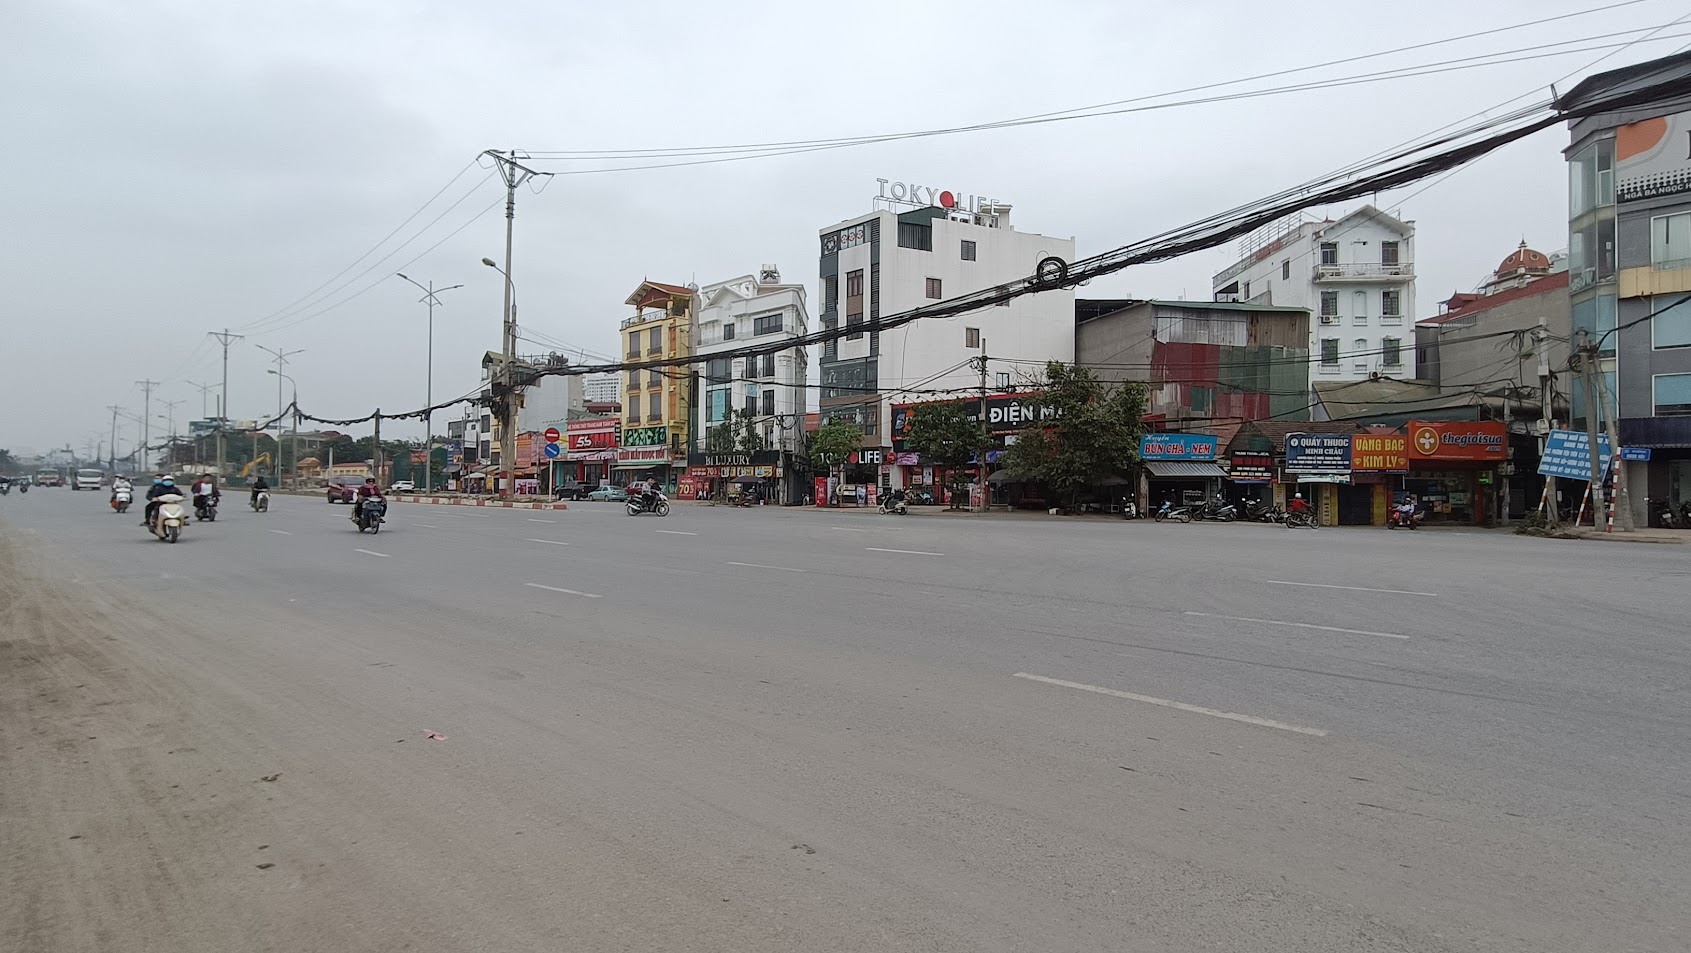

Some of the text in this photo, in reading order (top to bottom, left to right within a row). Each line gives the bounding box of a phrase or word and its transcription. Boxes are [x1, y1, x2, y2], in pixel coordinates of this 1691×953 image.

[1658, 184, 1684, 193] NGỌC
[989, 401, 1034, 425] ĐIỆN
[1190, 443, 1212, 454] NEM
[1355, 436, 1405, 453] VÀNG BẠC
[1324, 447, 1344, 455] CHÂU
[1362, 455, 1383, 468] KIM
